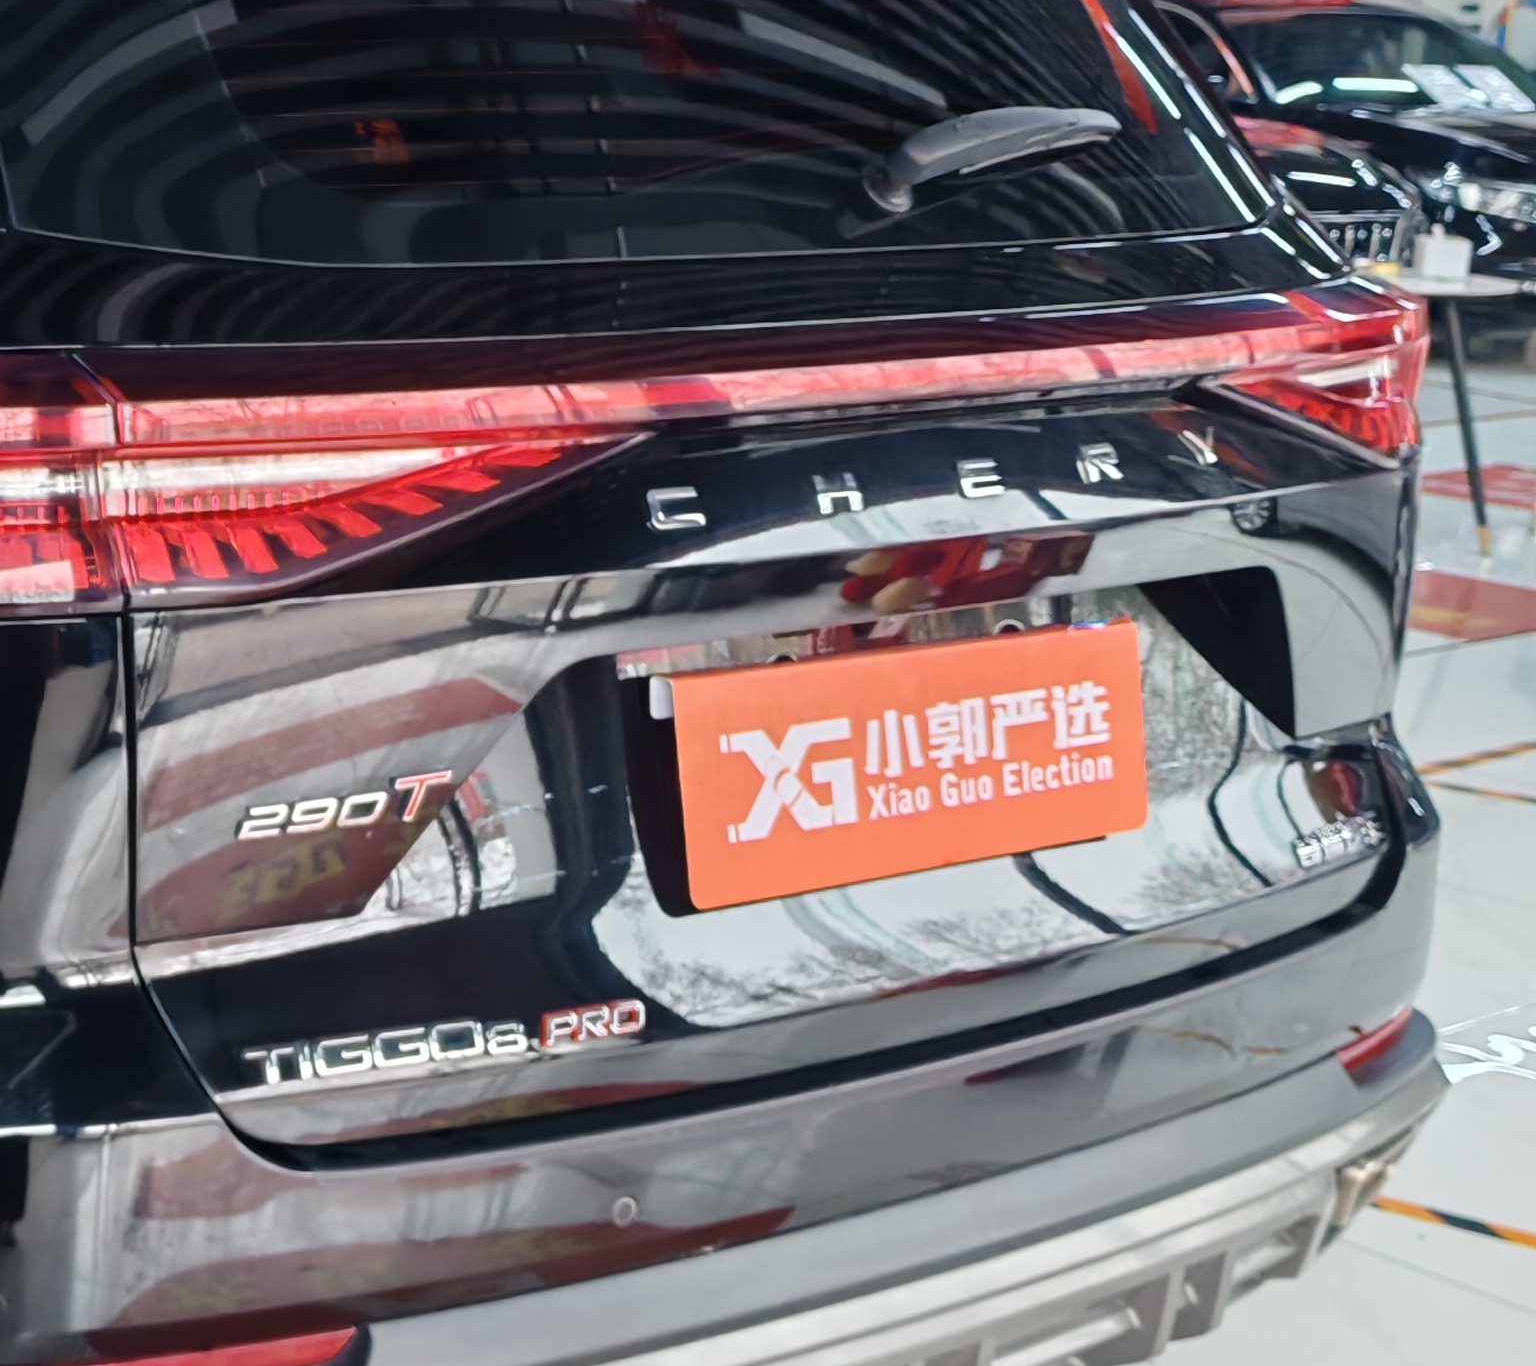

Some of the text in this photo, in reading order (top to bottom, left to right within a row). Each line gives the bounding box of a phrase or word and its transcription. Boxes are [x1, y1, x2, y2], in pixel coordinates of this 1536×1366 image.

[646, 426, 1219, 533] CHERY
[864, 680, 1112, 777] 小郭严选
[238, 769, 453, 841] 290T
[868, 754, 1114, 821] Xiao Guo Election
[541, 998, 646, 1048] PRO
